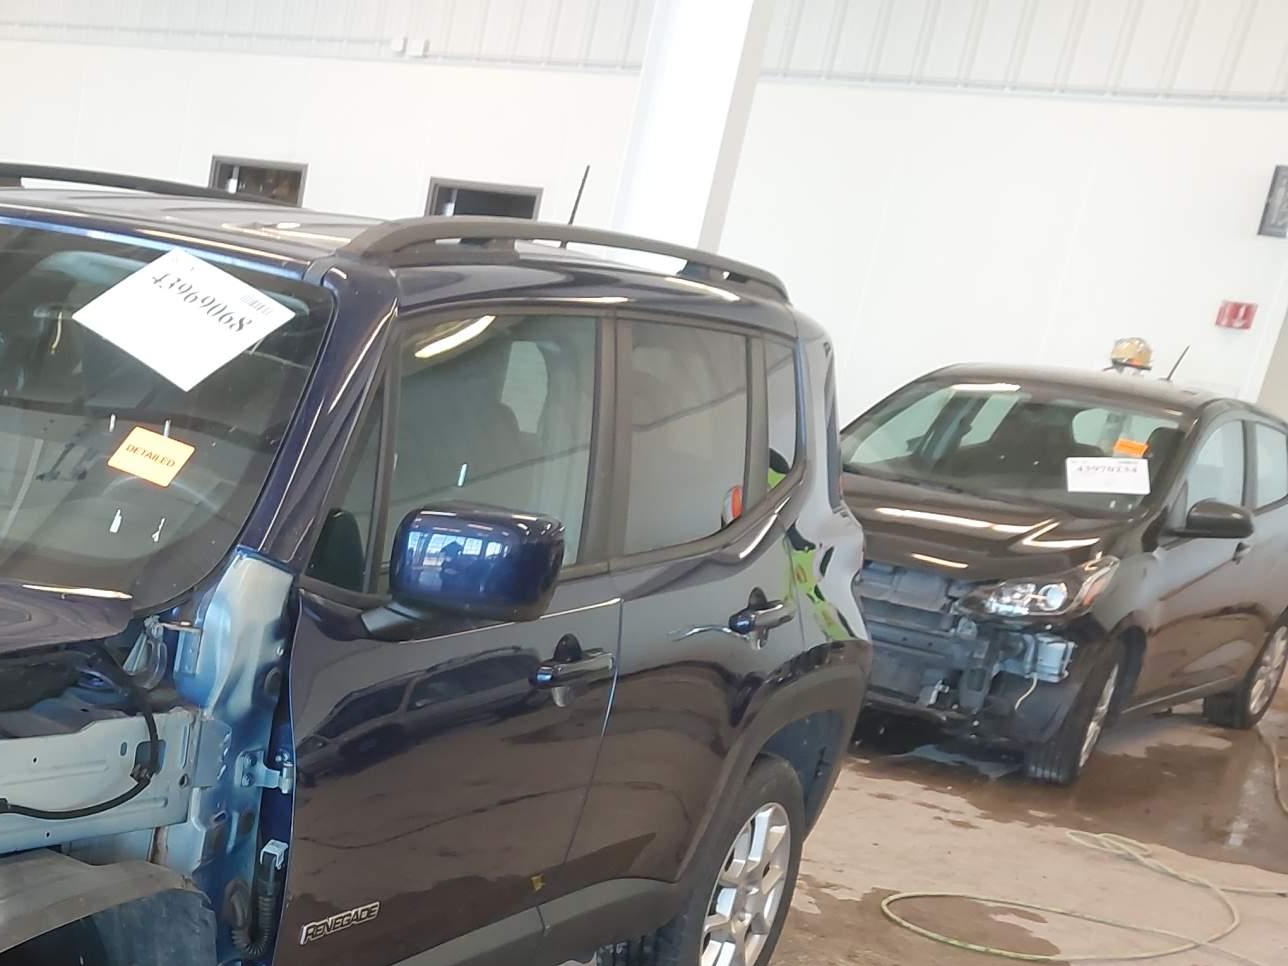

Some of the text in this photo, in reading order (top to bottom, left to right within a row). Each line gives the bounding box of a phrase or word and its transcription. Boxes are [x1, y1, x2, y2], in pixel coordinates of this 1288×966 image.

[152, 271, 253, 333] 43969068
[125, 443, 176, 468] DETAILED
[300, 901, 380, 945] RENEGADE
